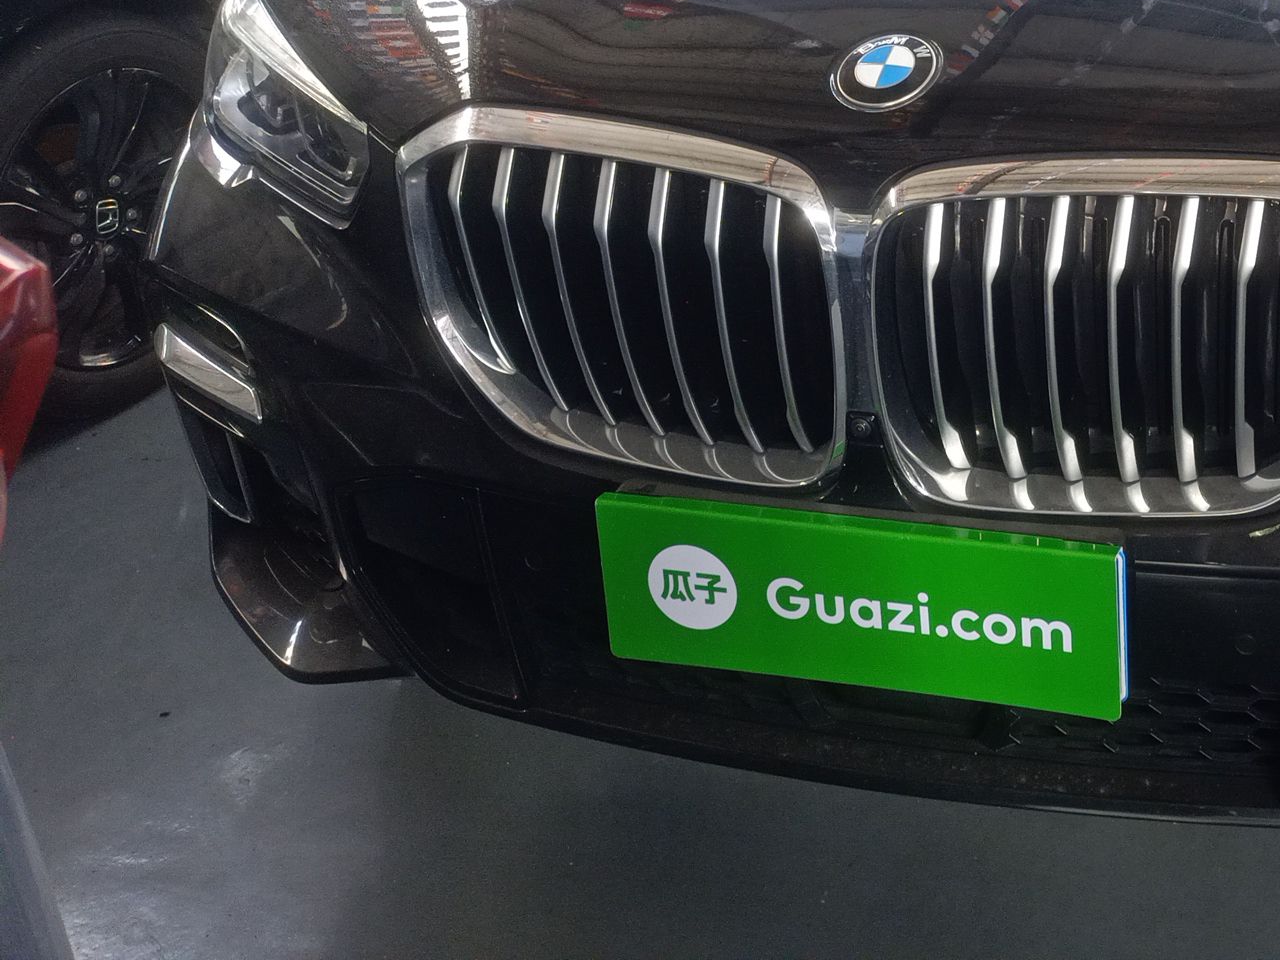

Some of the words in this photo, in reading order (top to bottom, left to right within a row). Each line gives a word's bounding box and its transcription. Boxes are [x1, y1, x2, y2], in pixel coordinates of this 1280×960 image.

[854, 36, 931, 58] BMW
[660, 568, 727, 605] 瓜子
[766, 577, 1073, 653] Guazi.com
